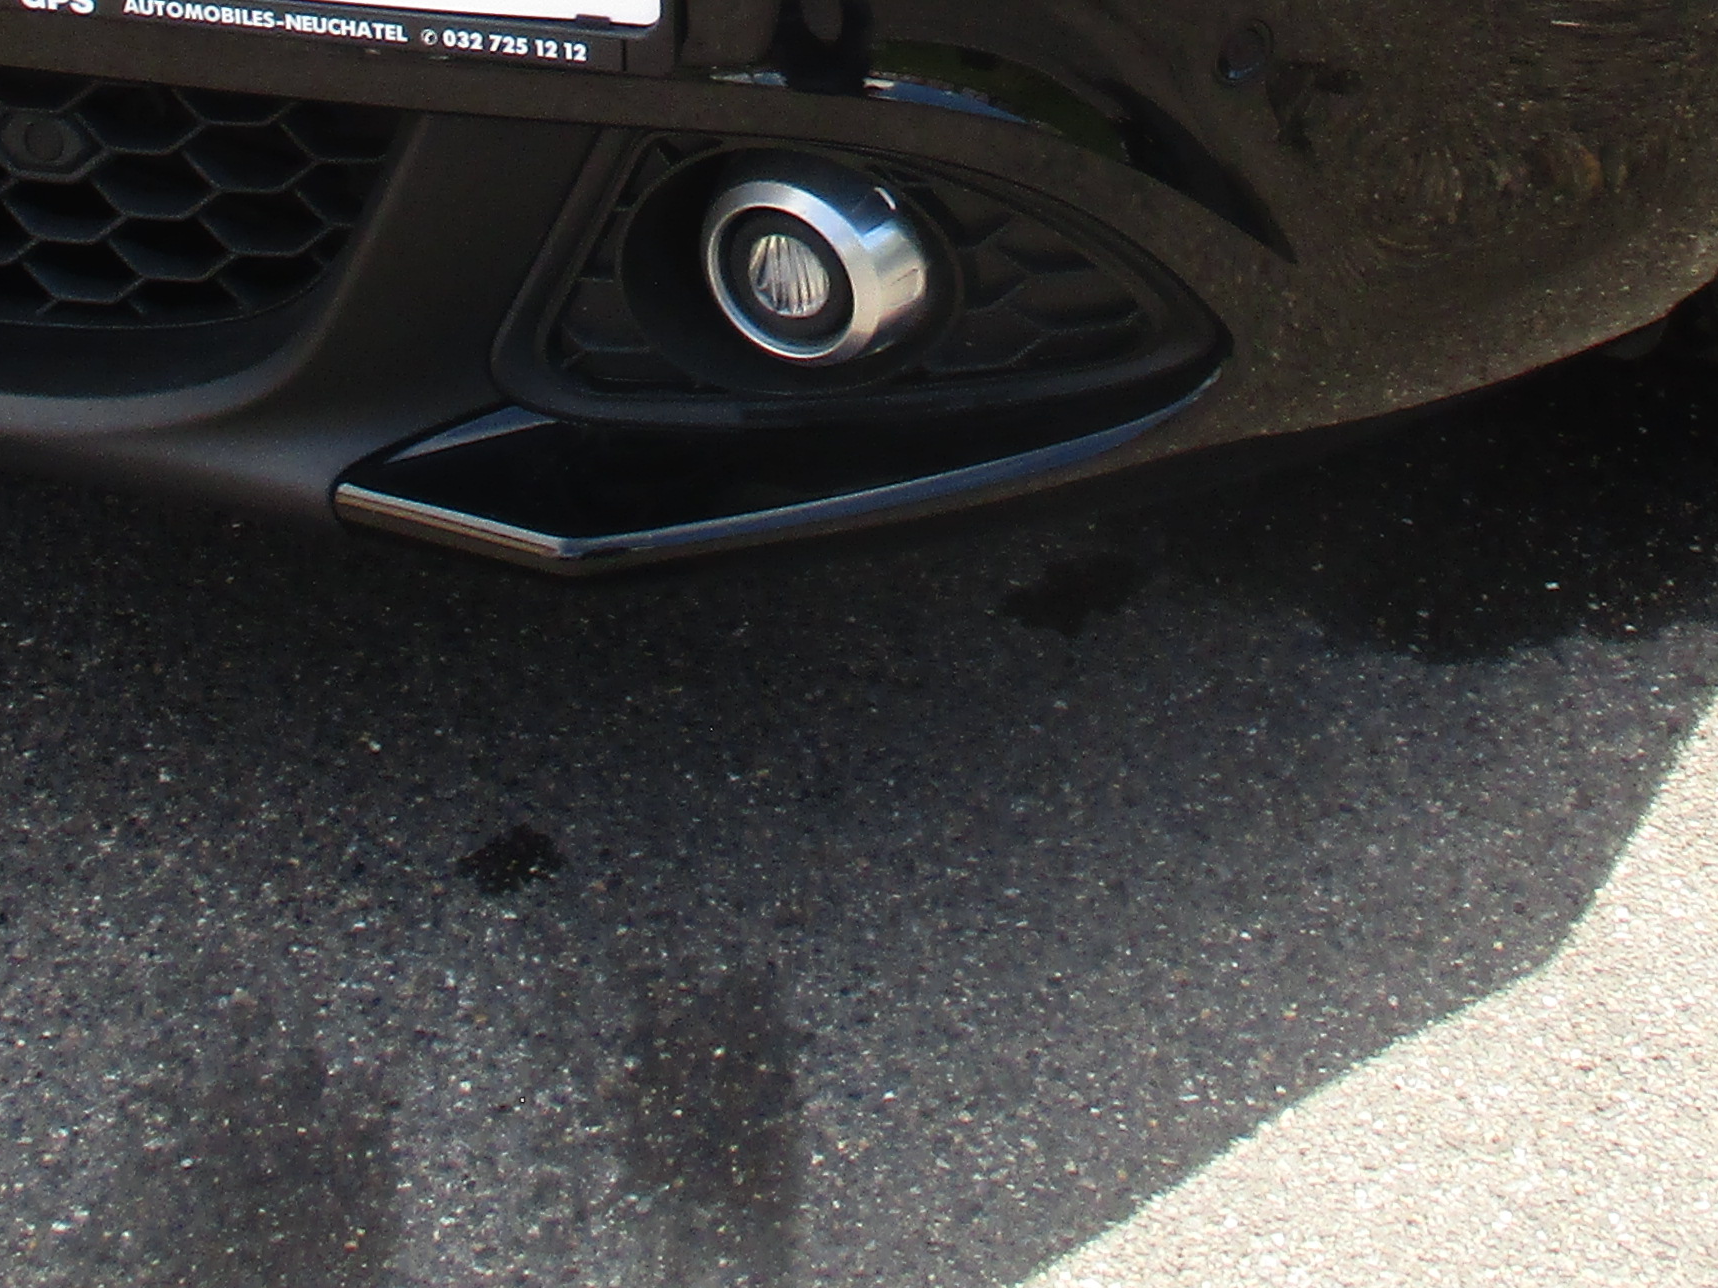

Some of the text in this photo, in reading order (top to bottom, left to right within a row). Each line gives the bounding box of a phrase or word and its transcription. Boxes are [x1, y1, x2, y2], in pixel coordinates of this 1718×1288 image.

[442, 28, 483, 51] 032
[488, 33, 529, 55] 725
[535, 38, 558, 60] 12
[563, 40, 587, 62] 12
